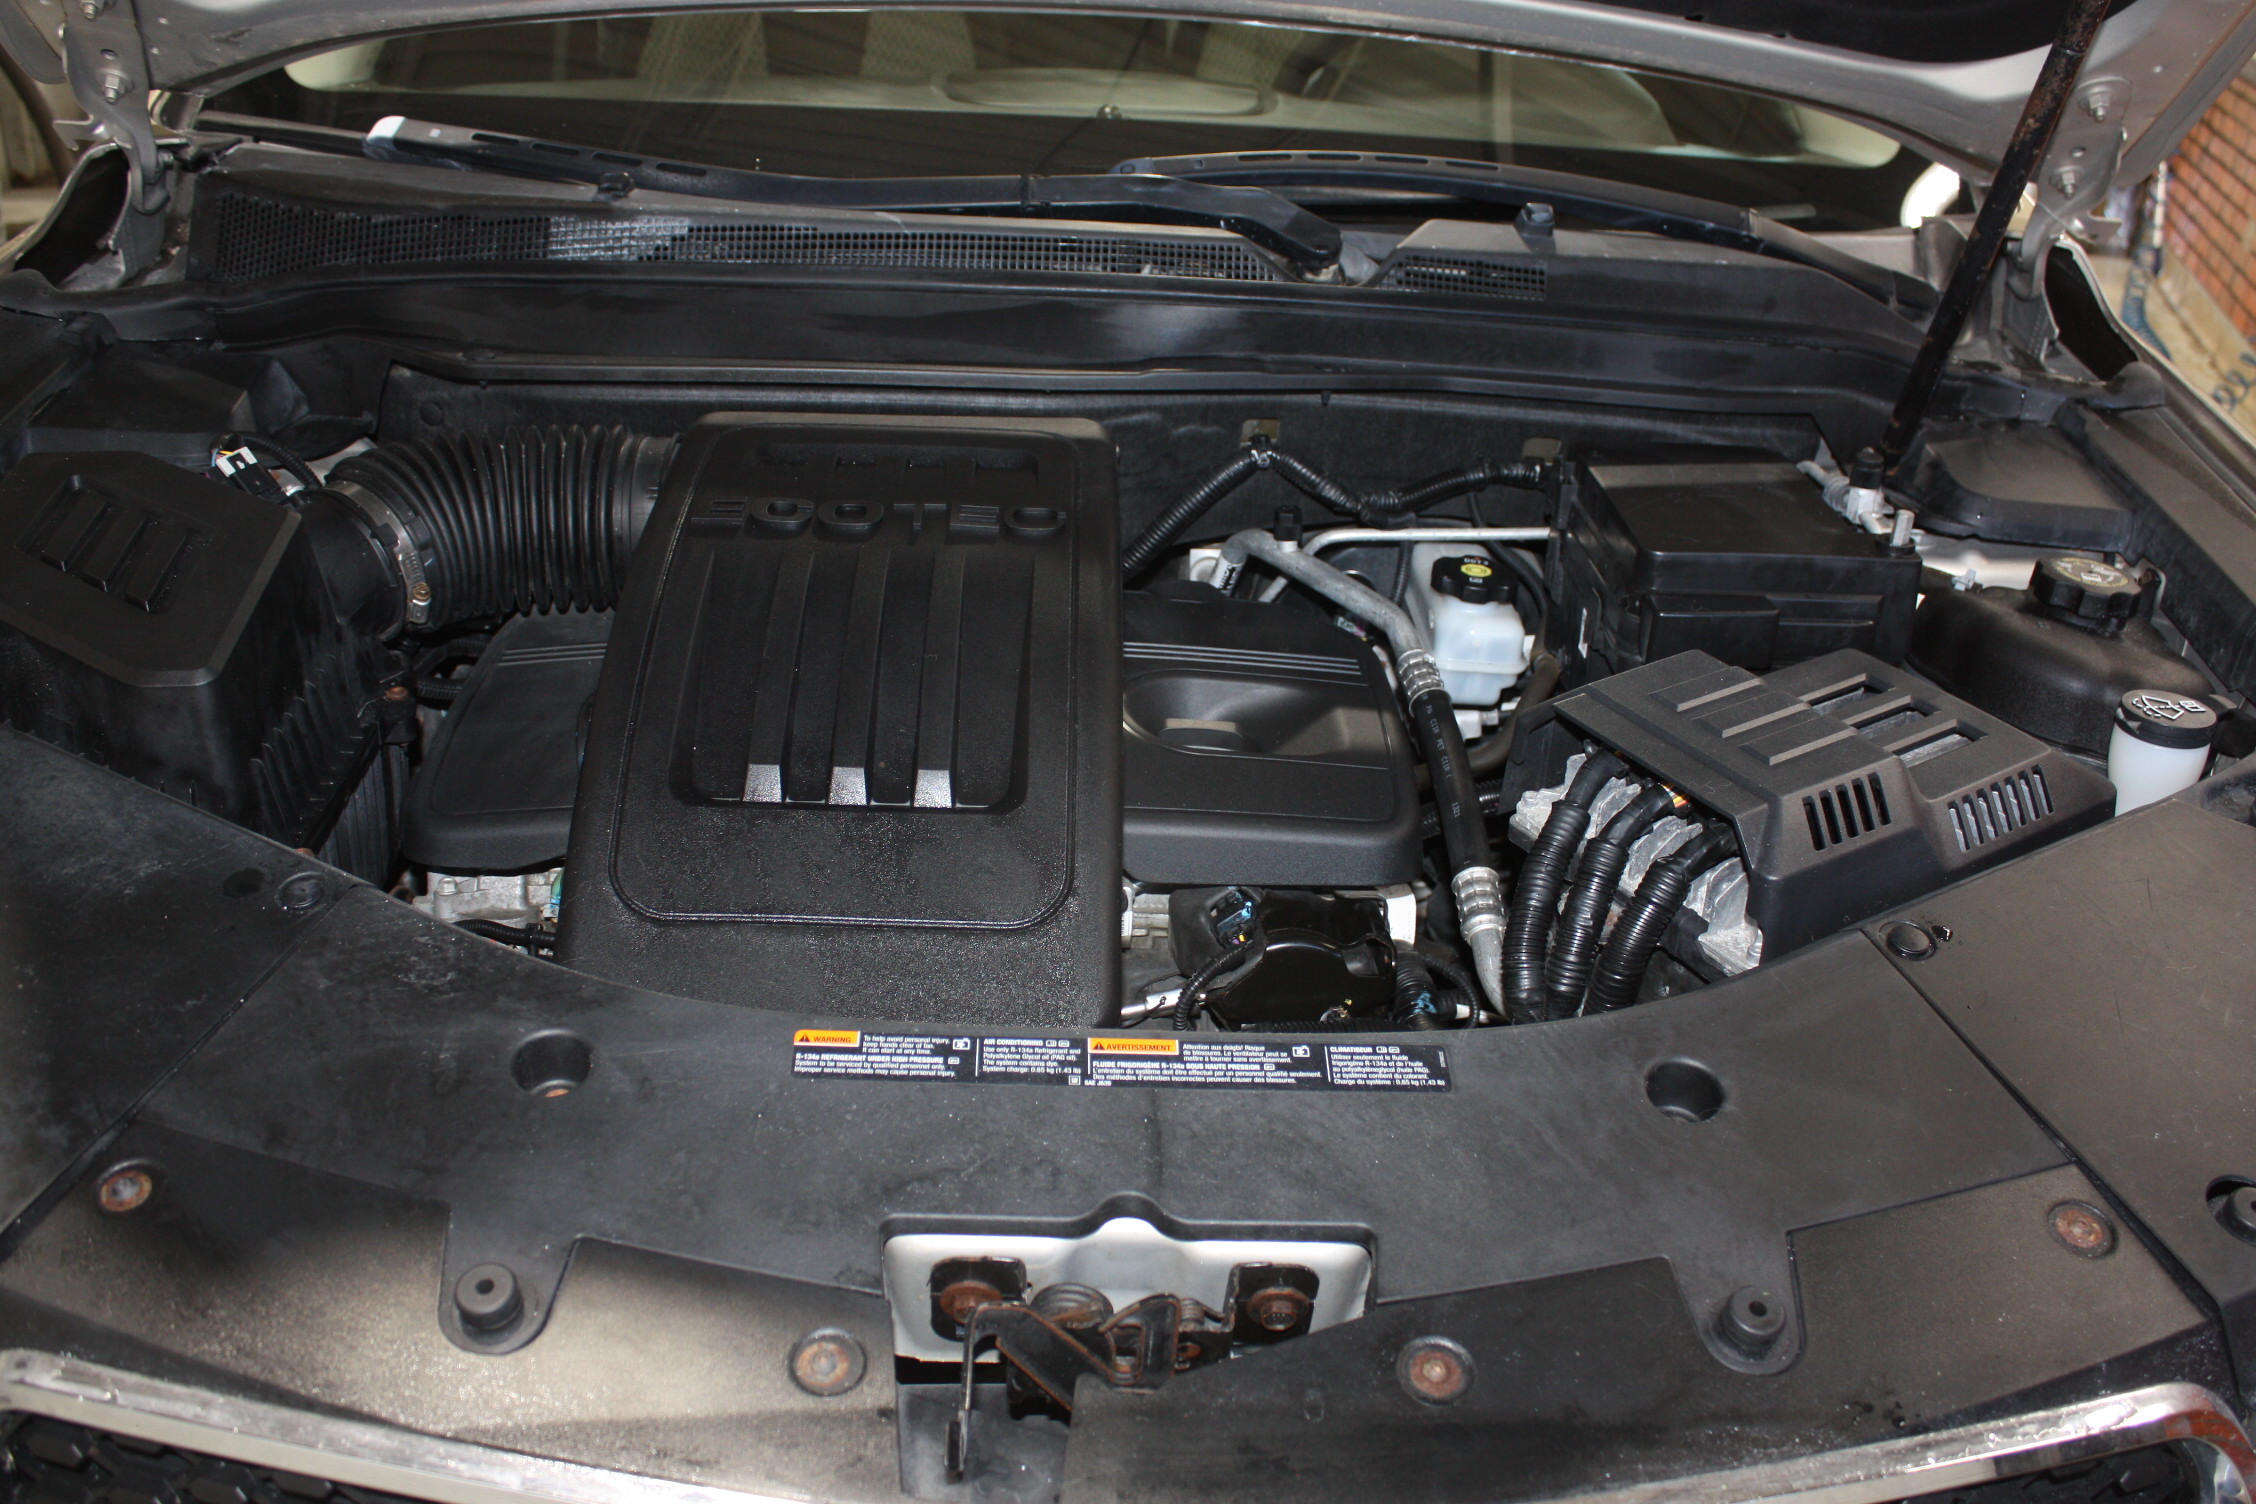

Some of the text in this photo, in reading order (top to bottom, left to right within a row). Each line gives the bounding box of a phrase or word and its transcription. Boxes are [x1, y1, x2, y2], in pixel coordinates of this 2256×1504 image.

[690, 496, 1067, 536] ECOTEC
[873, 1035, 886, 1043] help
[905, 1036, 930, 1044] personal
[794, 1066, 822, 1074] Improper
[900, 1062, 930, 1070] personnel
